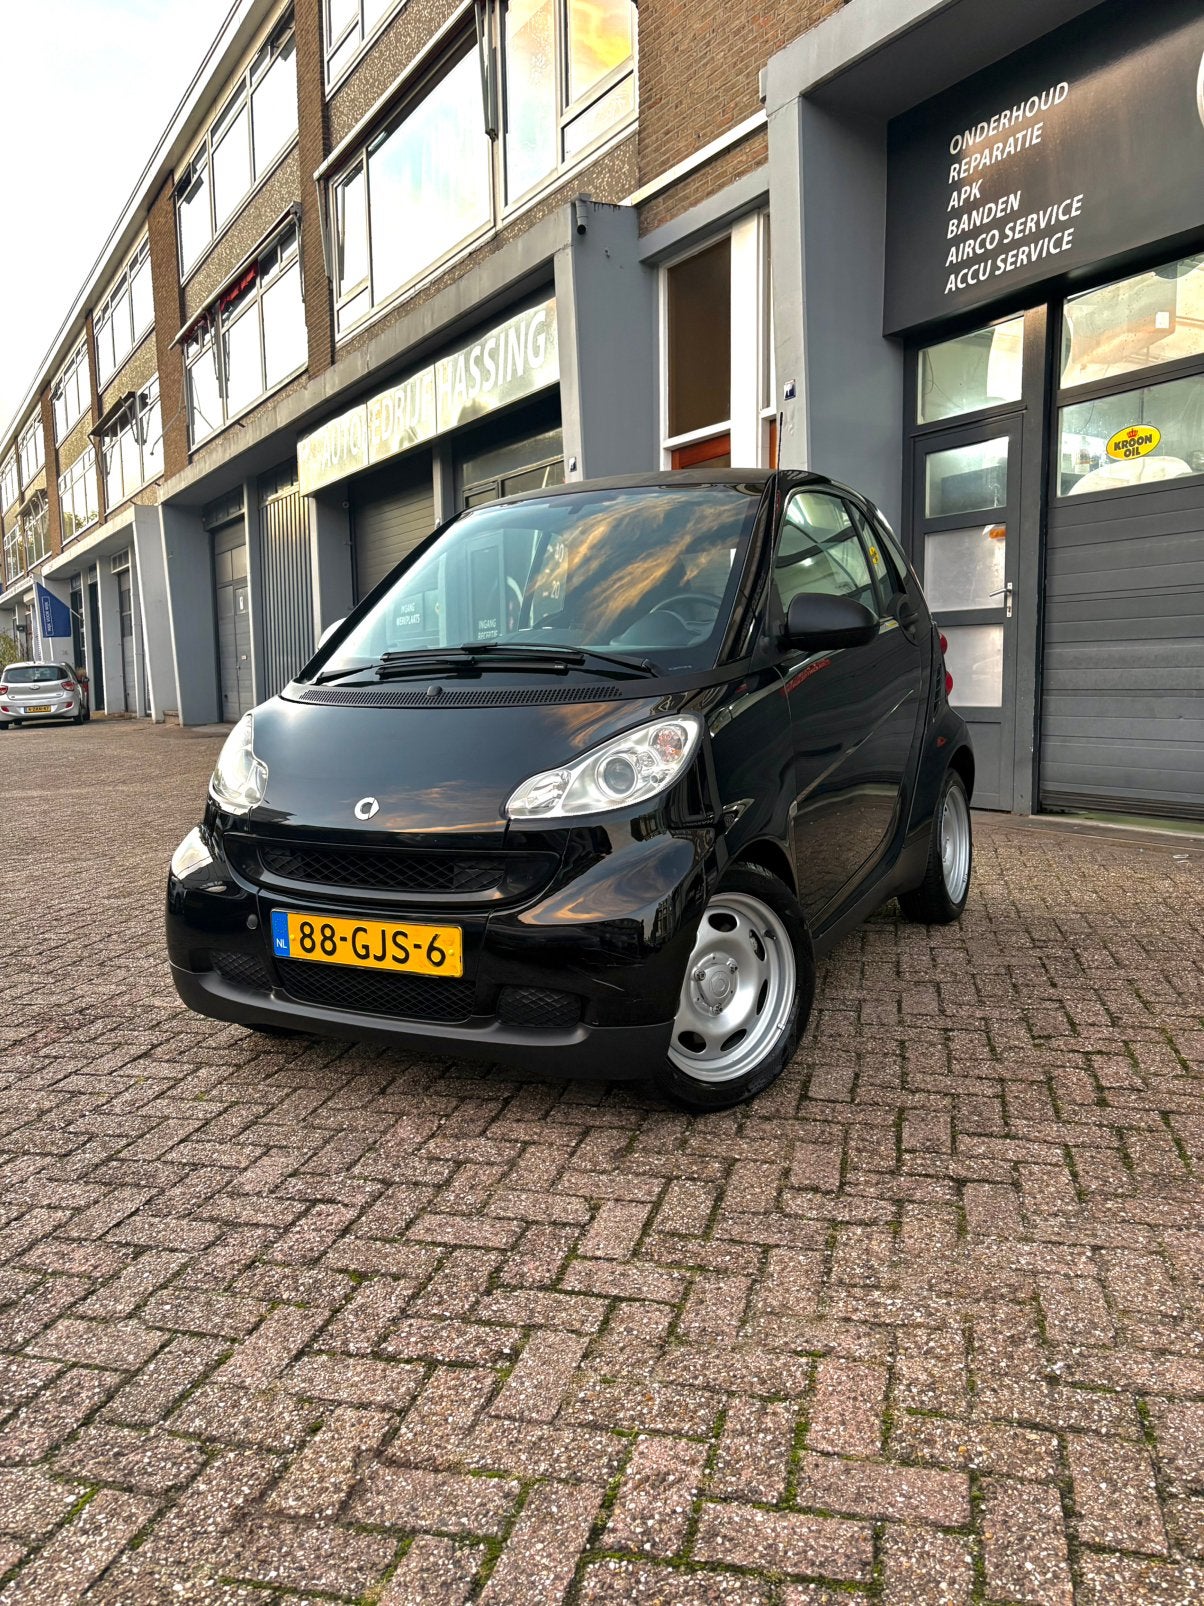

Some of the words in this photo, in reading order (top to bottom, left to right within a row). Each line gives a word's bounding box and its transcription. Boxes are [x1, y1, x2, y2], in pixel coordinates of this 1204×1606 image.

[950, 81, 1069, 155] ONDERHOUD
[949, 122, 1044, 184] REPARATIE
[947, 179, 984, 212] APK
[947, 191, 1021, 240] BANDEN
[945, 229, 999, 267] AIRCO
[1003, 194, 1084, 244] SERVICE
[944, 260, 992, 294] ACCU
[995, 228, 1075, 275] SERVICE
[437, 310, 547, 408] HASSING
[1114, 433, 1153, 451] KROON
[1124, 447, 1141, 458] OIL
[478, 618, 497, 630] INGANG
[276, 938, 288, 949] NL
[299, 921, 447, 967] 88-GJS-6
